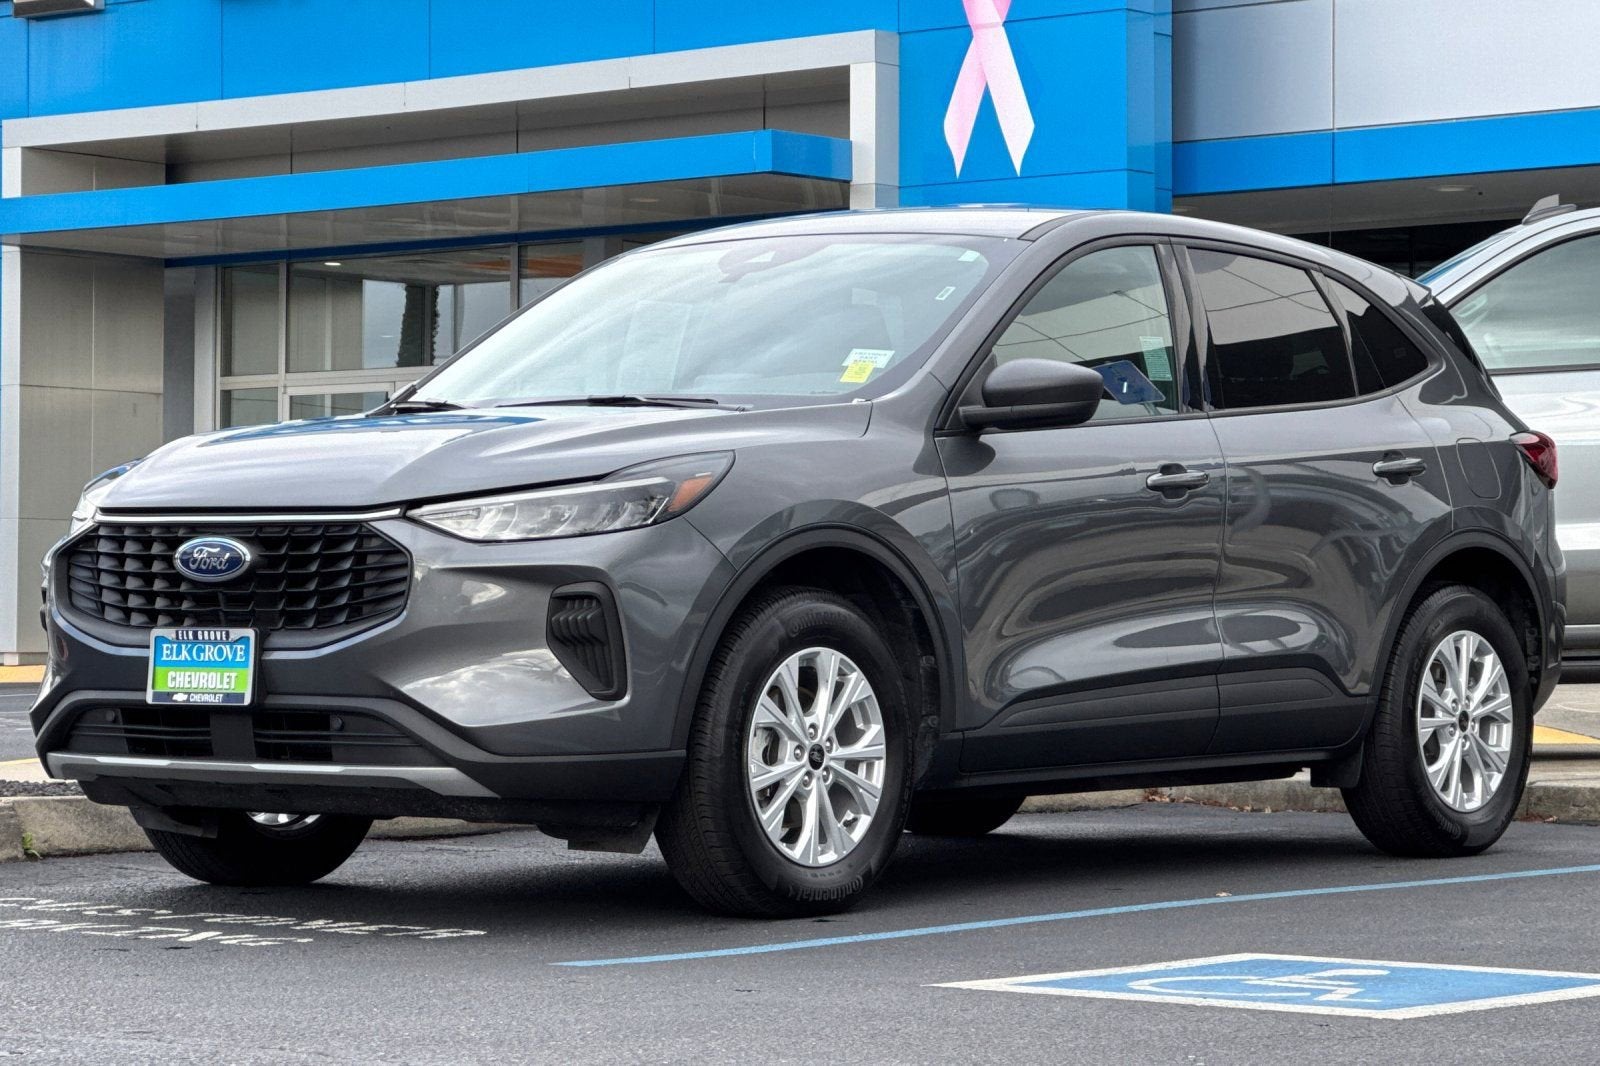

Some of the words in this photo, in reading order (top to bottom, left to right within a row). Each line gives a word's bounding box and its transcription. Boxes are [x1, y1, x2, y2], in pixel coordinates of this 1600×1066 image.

[189, 546, 230, 569] Ford
[178, 631, 194, 641] ELK
[198, 631, 227, 641] GROVE
[167, 671, 238, 690] CHEVROLET
[189, 693, 224, 703] CHEVROLET
